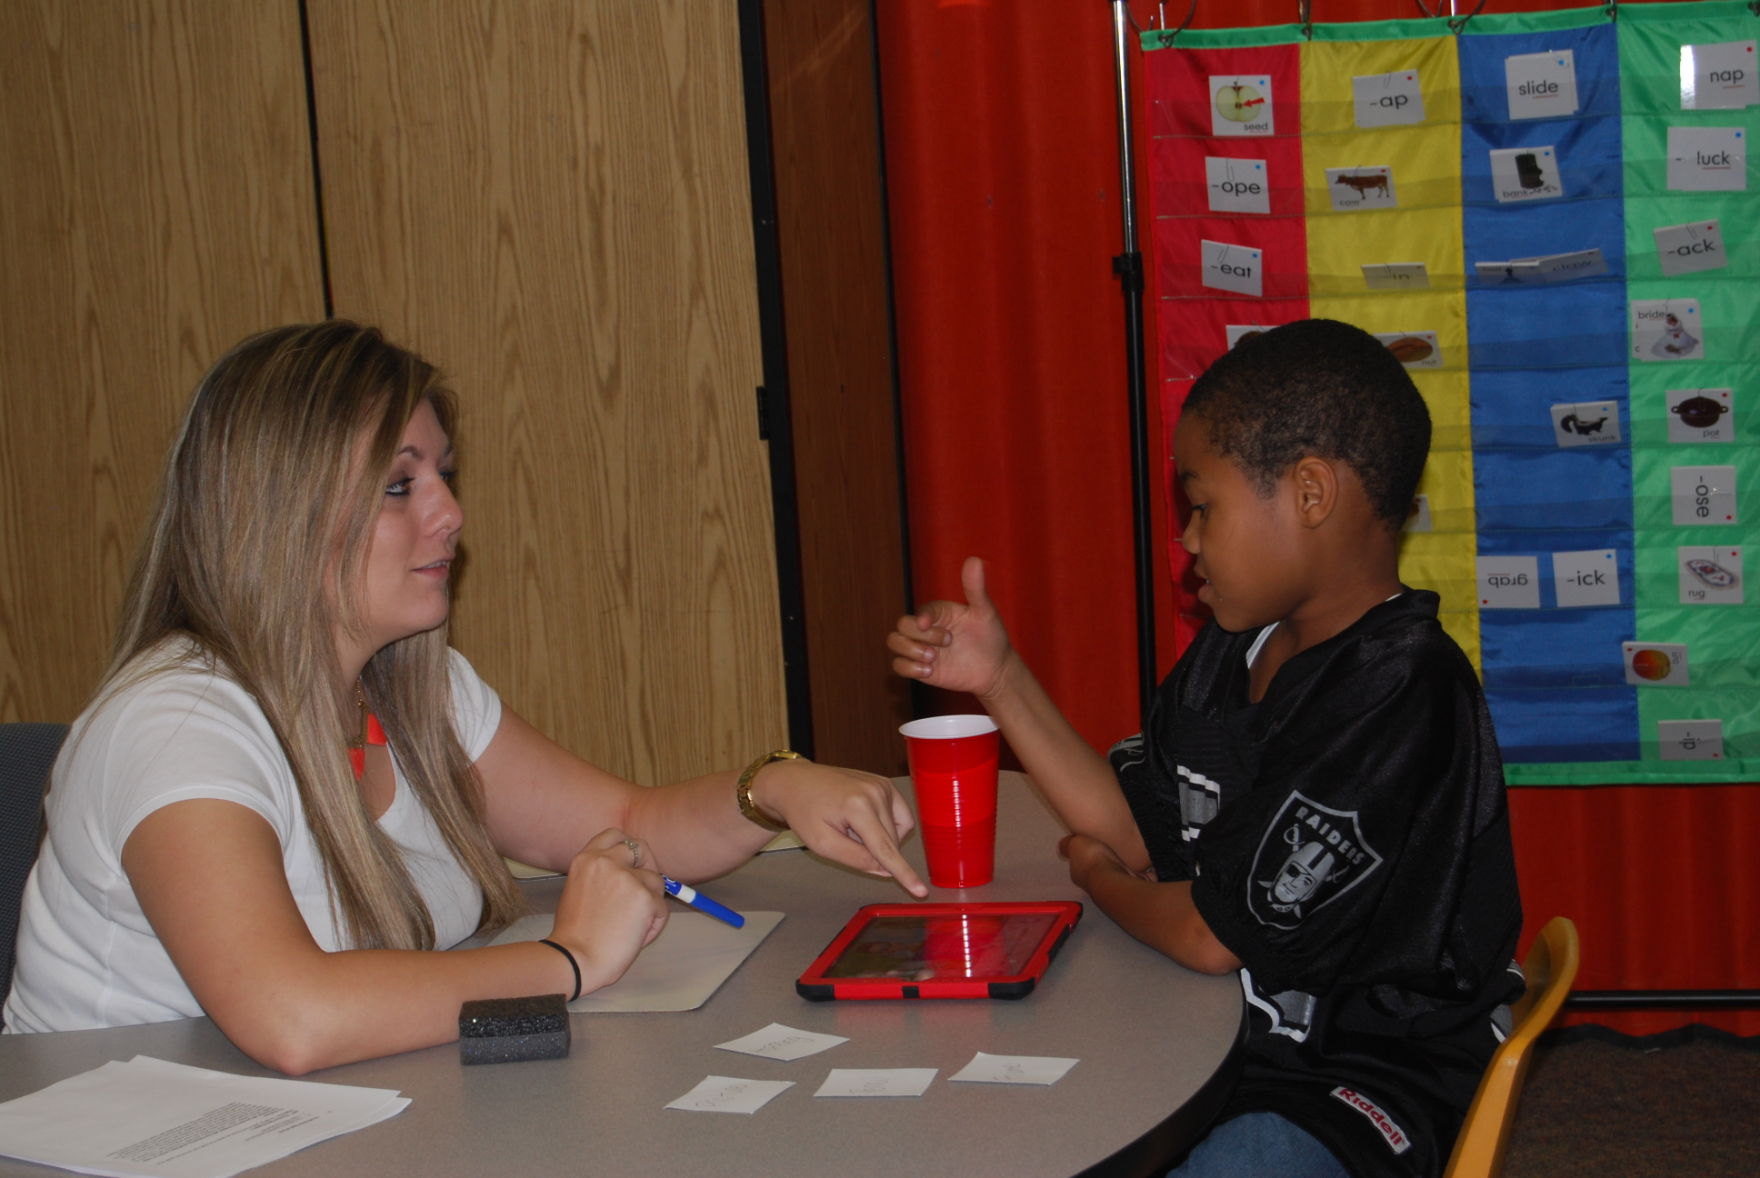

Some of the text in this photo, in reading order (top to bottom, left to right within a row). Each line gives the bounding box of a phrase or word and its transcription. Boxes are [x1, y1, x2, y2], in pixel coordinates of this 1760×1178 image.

[1709, 69, 1744, 84] nap
[1518, 79, 1559, 96] slide
[1369, 93, 1408, 110] -ap
[1211, 180, 1261, 197] -ope
[1667, 239, 1716, 257] -ack
[1210, 263, 1252, 279] -eat
[1637, 309, 1665, 320] bride
[1695, 475, 1710, 518] -ose
[1487, 574, 1529, 588] grab
[1567, 569, 1606, 586] -ick
[1295, 805, 1365, 867] RAIDERS
[1337, 1085, 1404, 1147] Riddell
